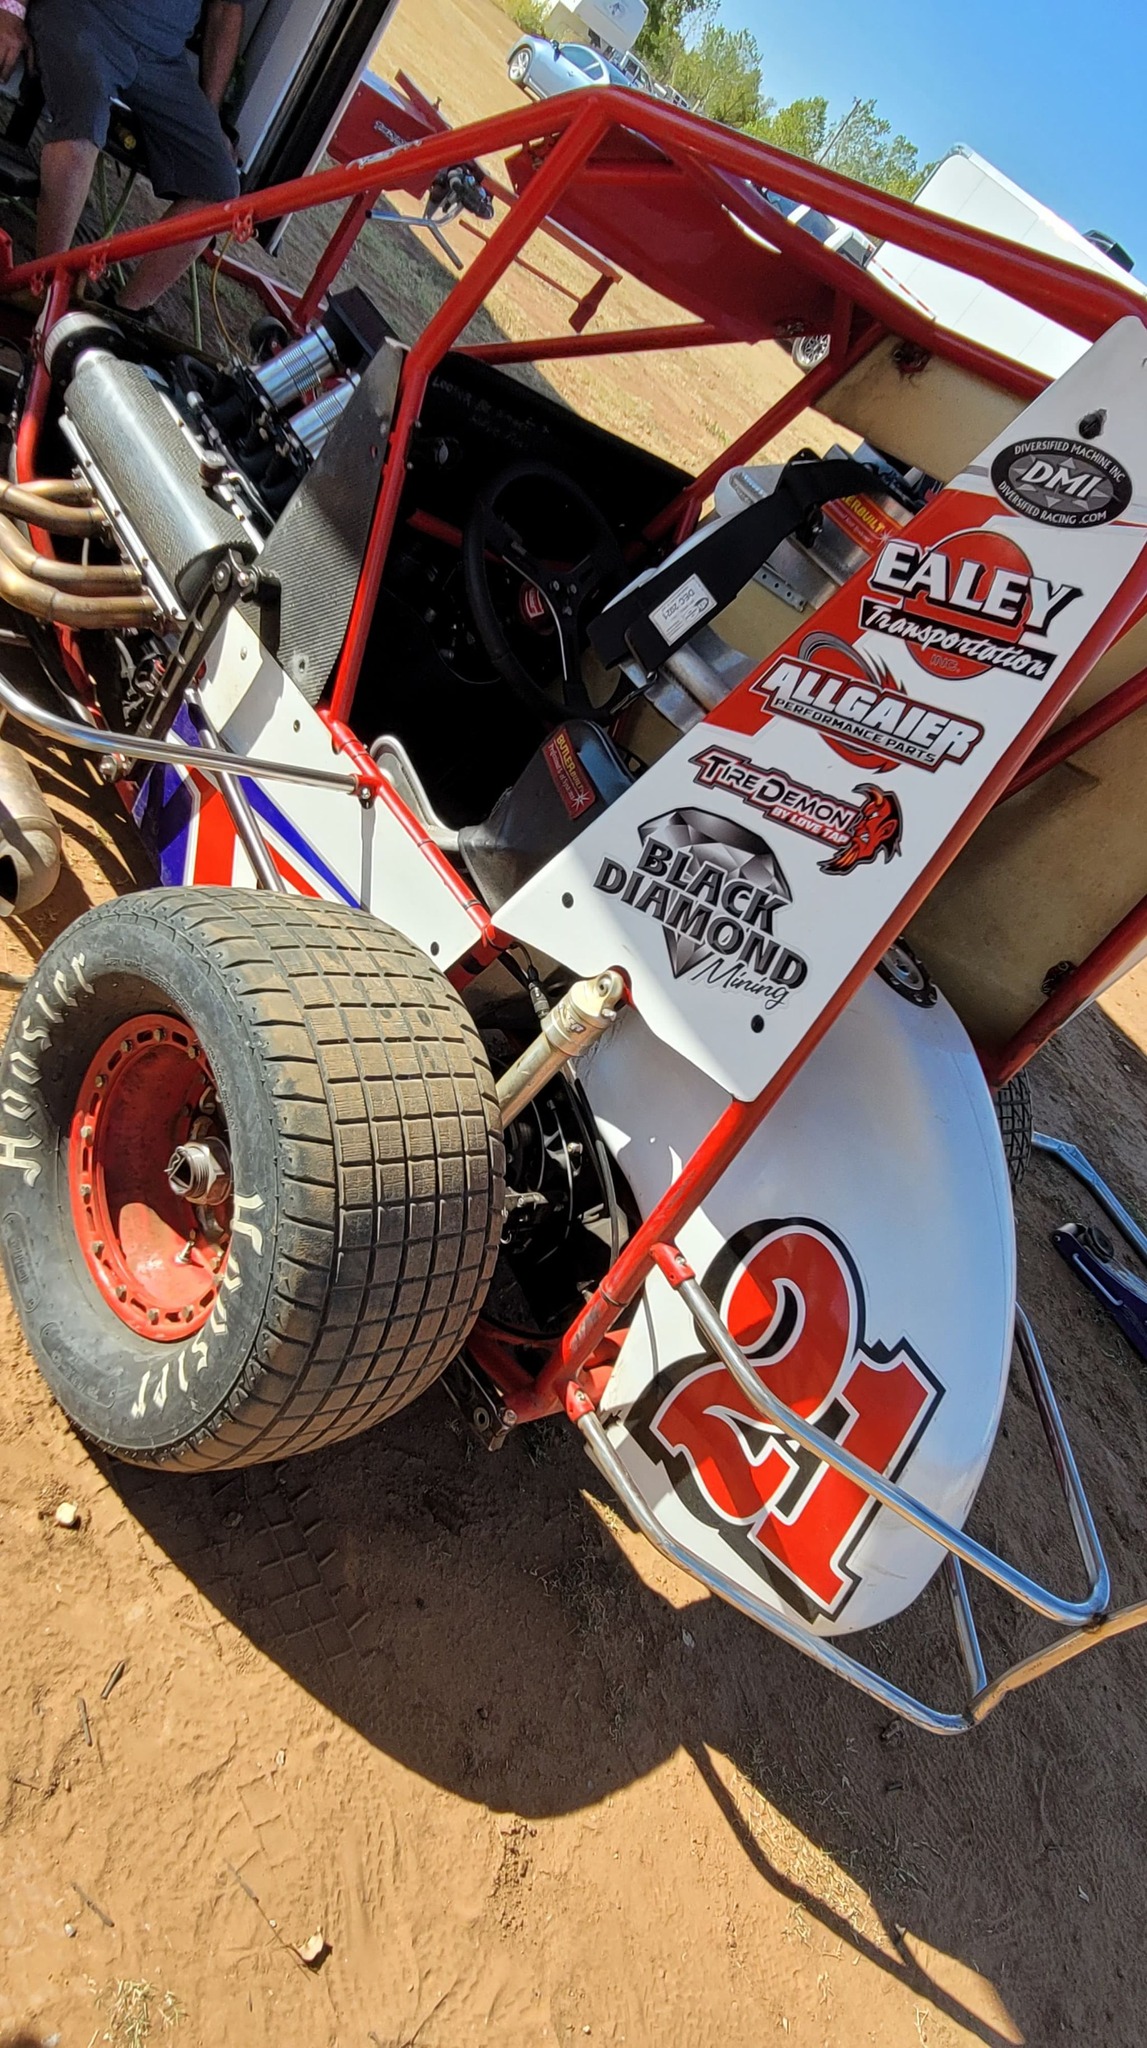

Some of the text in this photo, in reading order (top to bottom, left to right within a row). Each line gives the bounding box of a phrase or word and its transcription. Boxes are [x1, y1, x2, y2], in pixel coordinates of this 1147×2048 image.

[1014, 440, 1126, 483] DIVERSIFIED MACHINE INC
[1021, 460, 1103, 498] DMI
[998, 480, 1041, 517] DIVERSIFIED
[1040, 510, 1077, 525] RACING
[870, 540, 1083, 637] EALEY
[864, 604, 1047, 677] Transportation
[929, 653, 961, 673] INC.
[761, 662, 982, 759] ALLGAIER
[773, 697, 937, 764] PERFORMANCE PARTS
[770, 806, 850, 845] BY LOVE TAP
[636, 837, 791, 936] BLACK
[592, 856, 809, 990] DIAMOND
[690, 951, 790, 1011] Mining
[626, 1217, 946, 1622] 21
